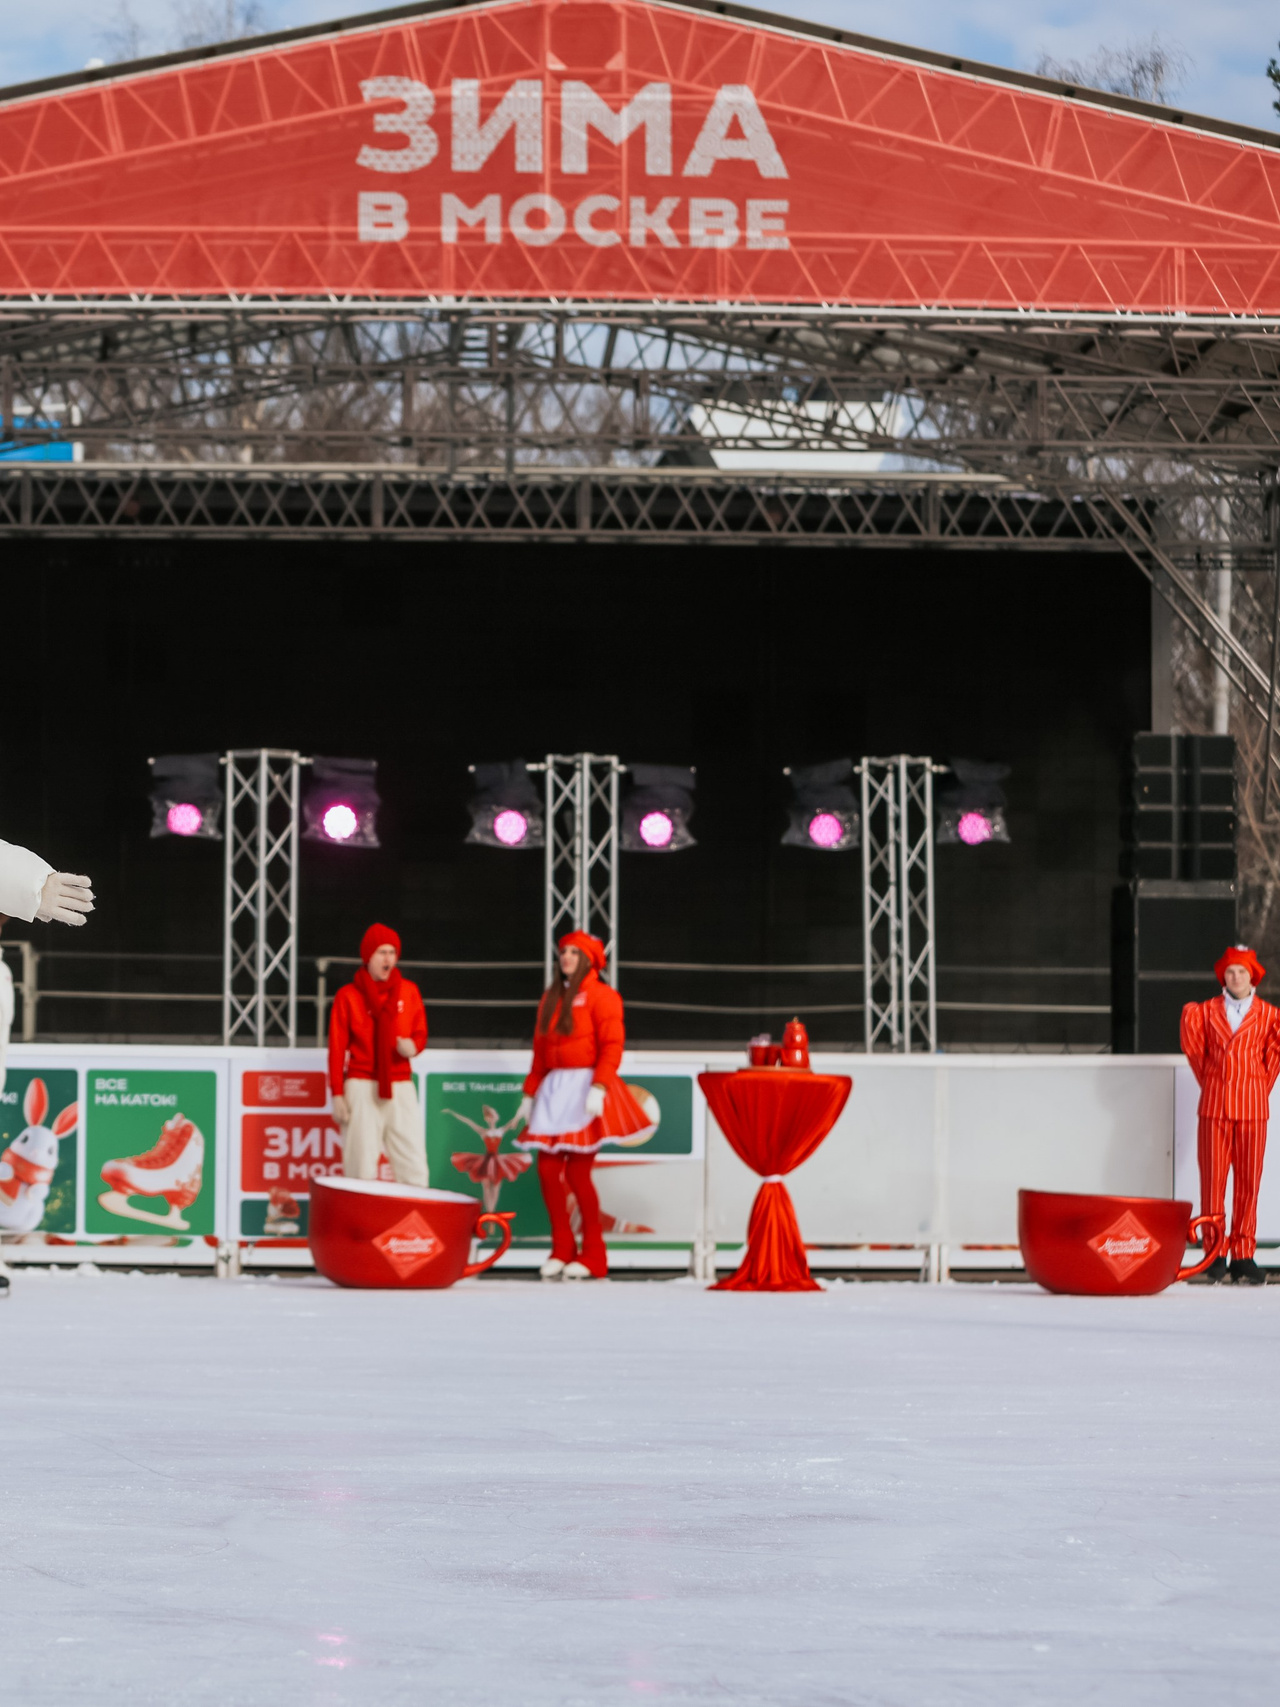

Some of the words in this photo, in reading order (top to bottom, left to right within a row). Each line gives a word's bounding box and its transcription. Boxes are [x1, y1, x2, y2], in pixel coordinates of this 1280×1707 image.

[356, 75, 790, 179] ЗИМА
[357, 191, 409, 242] В
[440, 193, 791, 250] МОСКВЕ
[94, 1078, 128, 1091] ВСЕ
[442, 1082, 466, 1092] ВСЕ
[94, 1094, 119, 1105] НА
[263, 1162, 280, 1179] В
